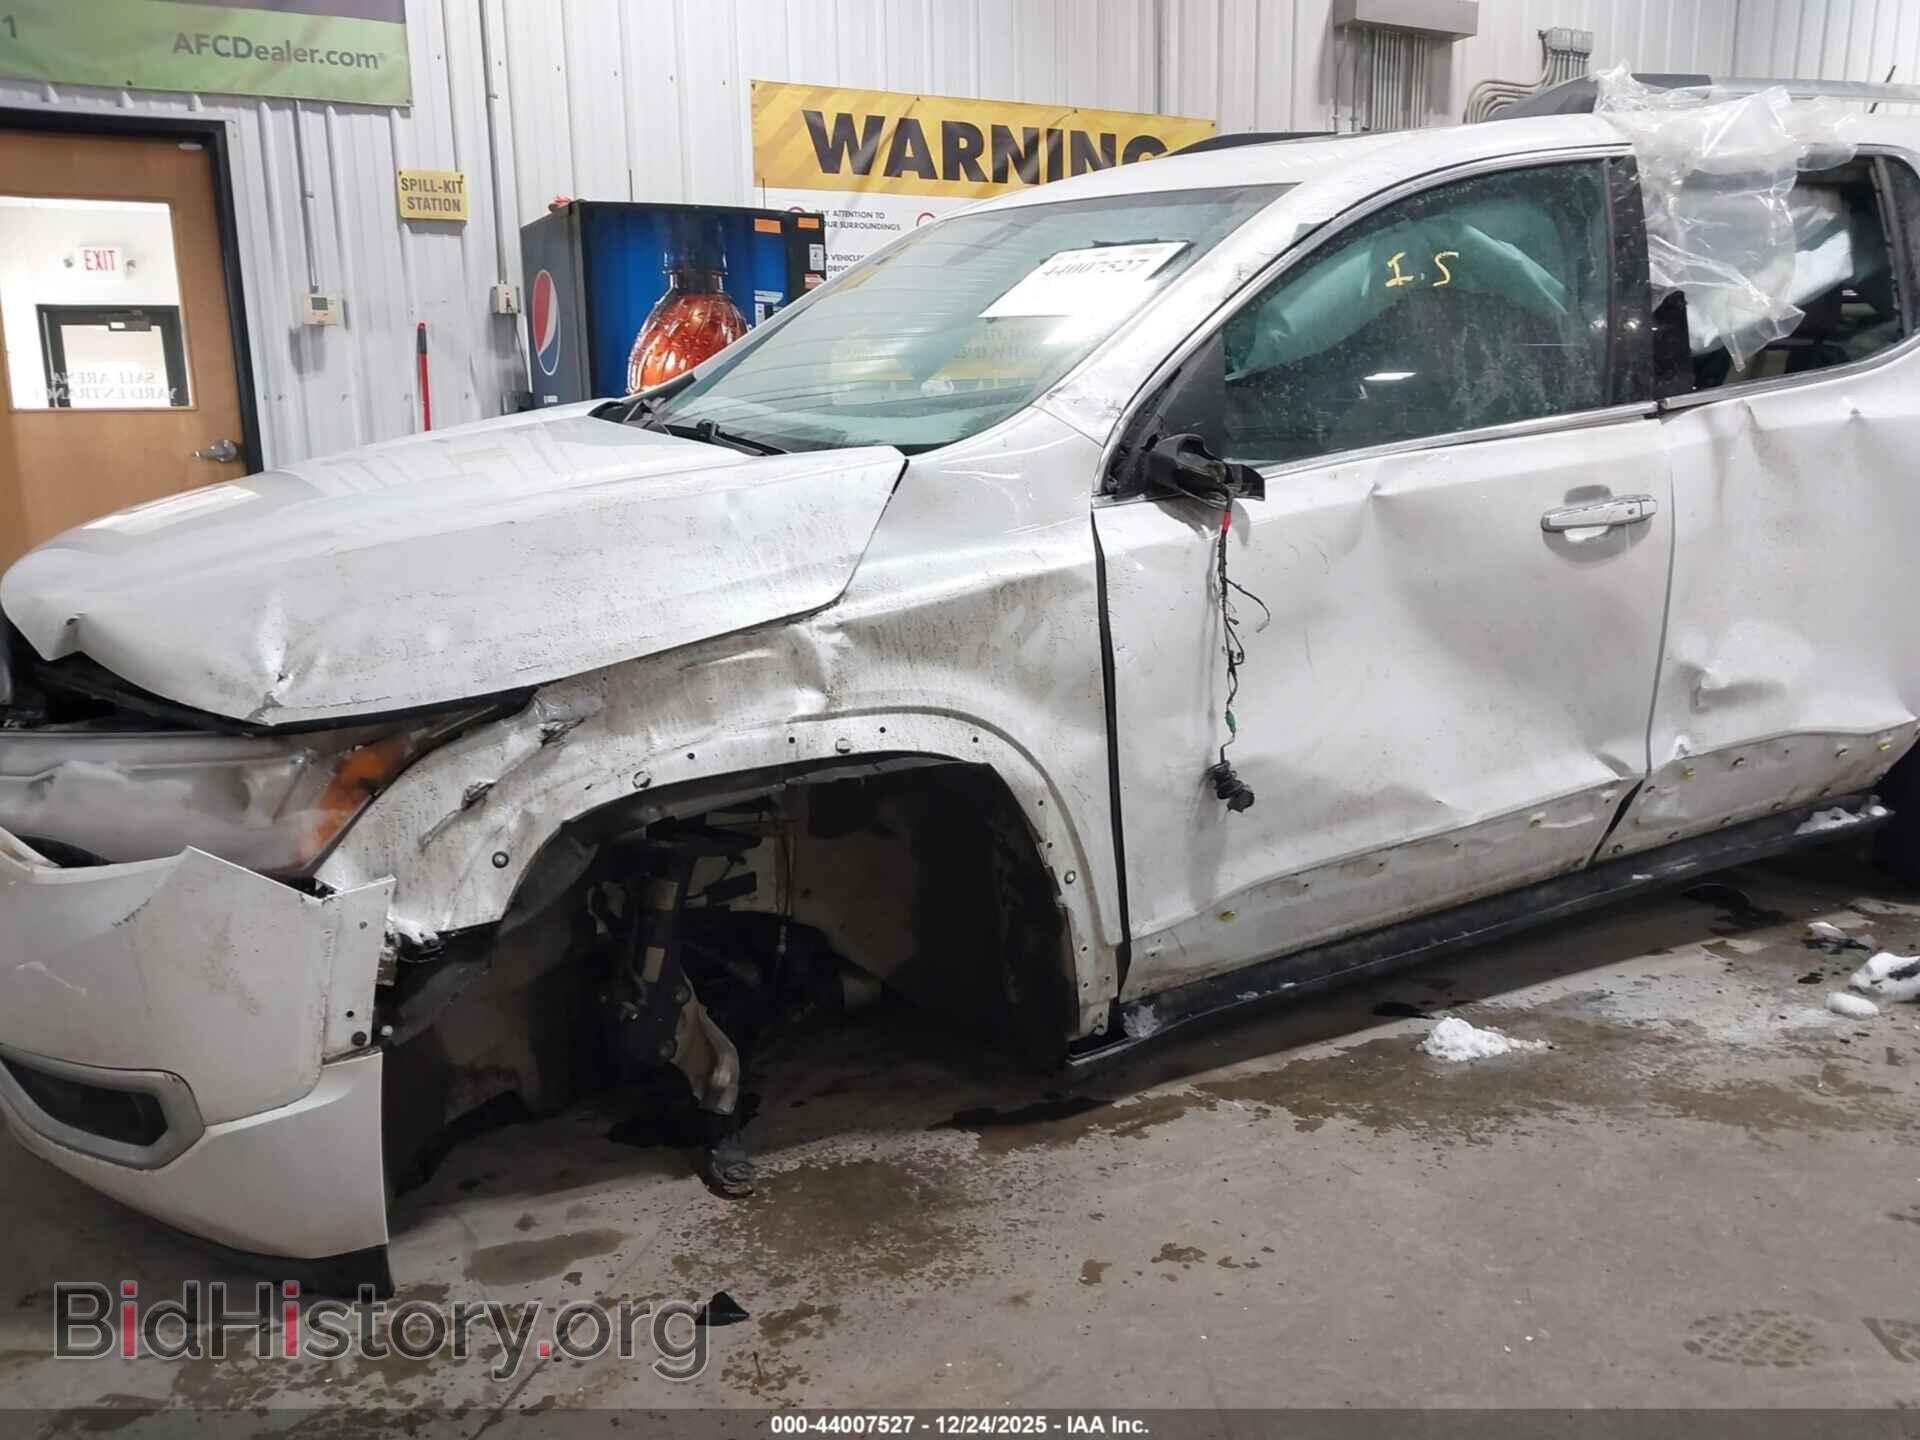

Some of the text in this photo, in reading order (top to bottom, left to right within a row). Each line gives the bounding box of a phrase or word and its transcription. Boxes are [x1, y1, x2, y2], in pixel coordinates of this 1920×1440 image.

[401, 177, 463, 194] SPILL-KIT
[408, 196, 461, 212] STATION
[833, 210, 873, 219] ATTENTION
[875, 211, 886, 219] TO
[840, 221, 901, 231] SURROUNDINGS
[84, 249, 116, 271] EXIT
